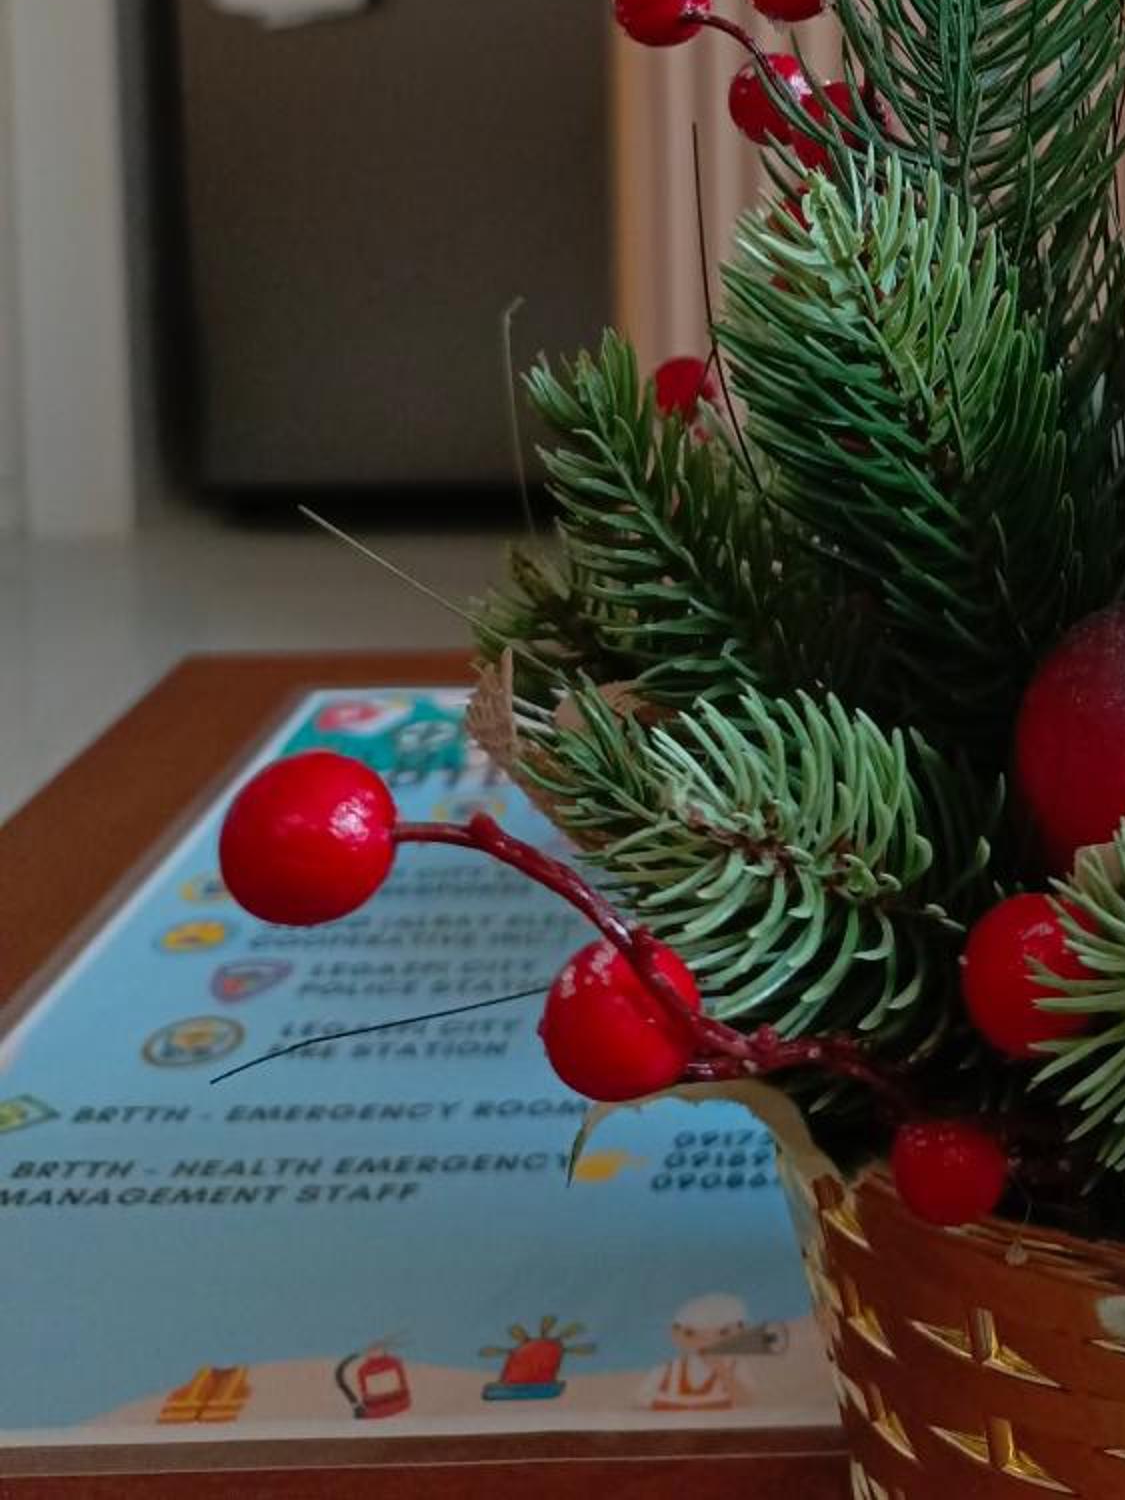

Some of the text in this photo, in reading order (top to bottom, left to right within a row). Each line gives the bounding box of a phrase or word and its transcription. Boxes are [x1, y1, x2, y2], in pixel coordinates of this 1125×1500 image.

[350, 1040, 509, 1060] STATION
[224, 1101, 462, 1123] EMERGENCY
[171, 1156, 322, 1179] HEALTH
[332, 1151, 572, 1176] EMERGENCY
[0, 1182, 422, 1208] MANAGEMENT STAFF
